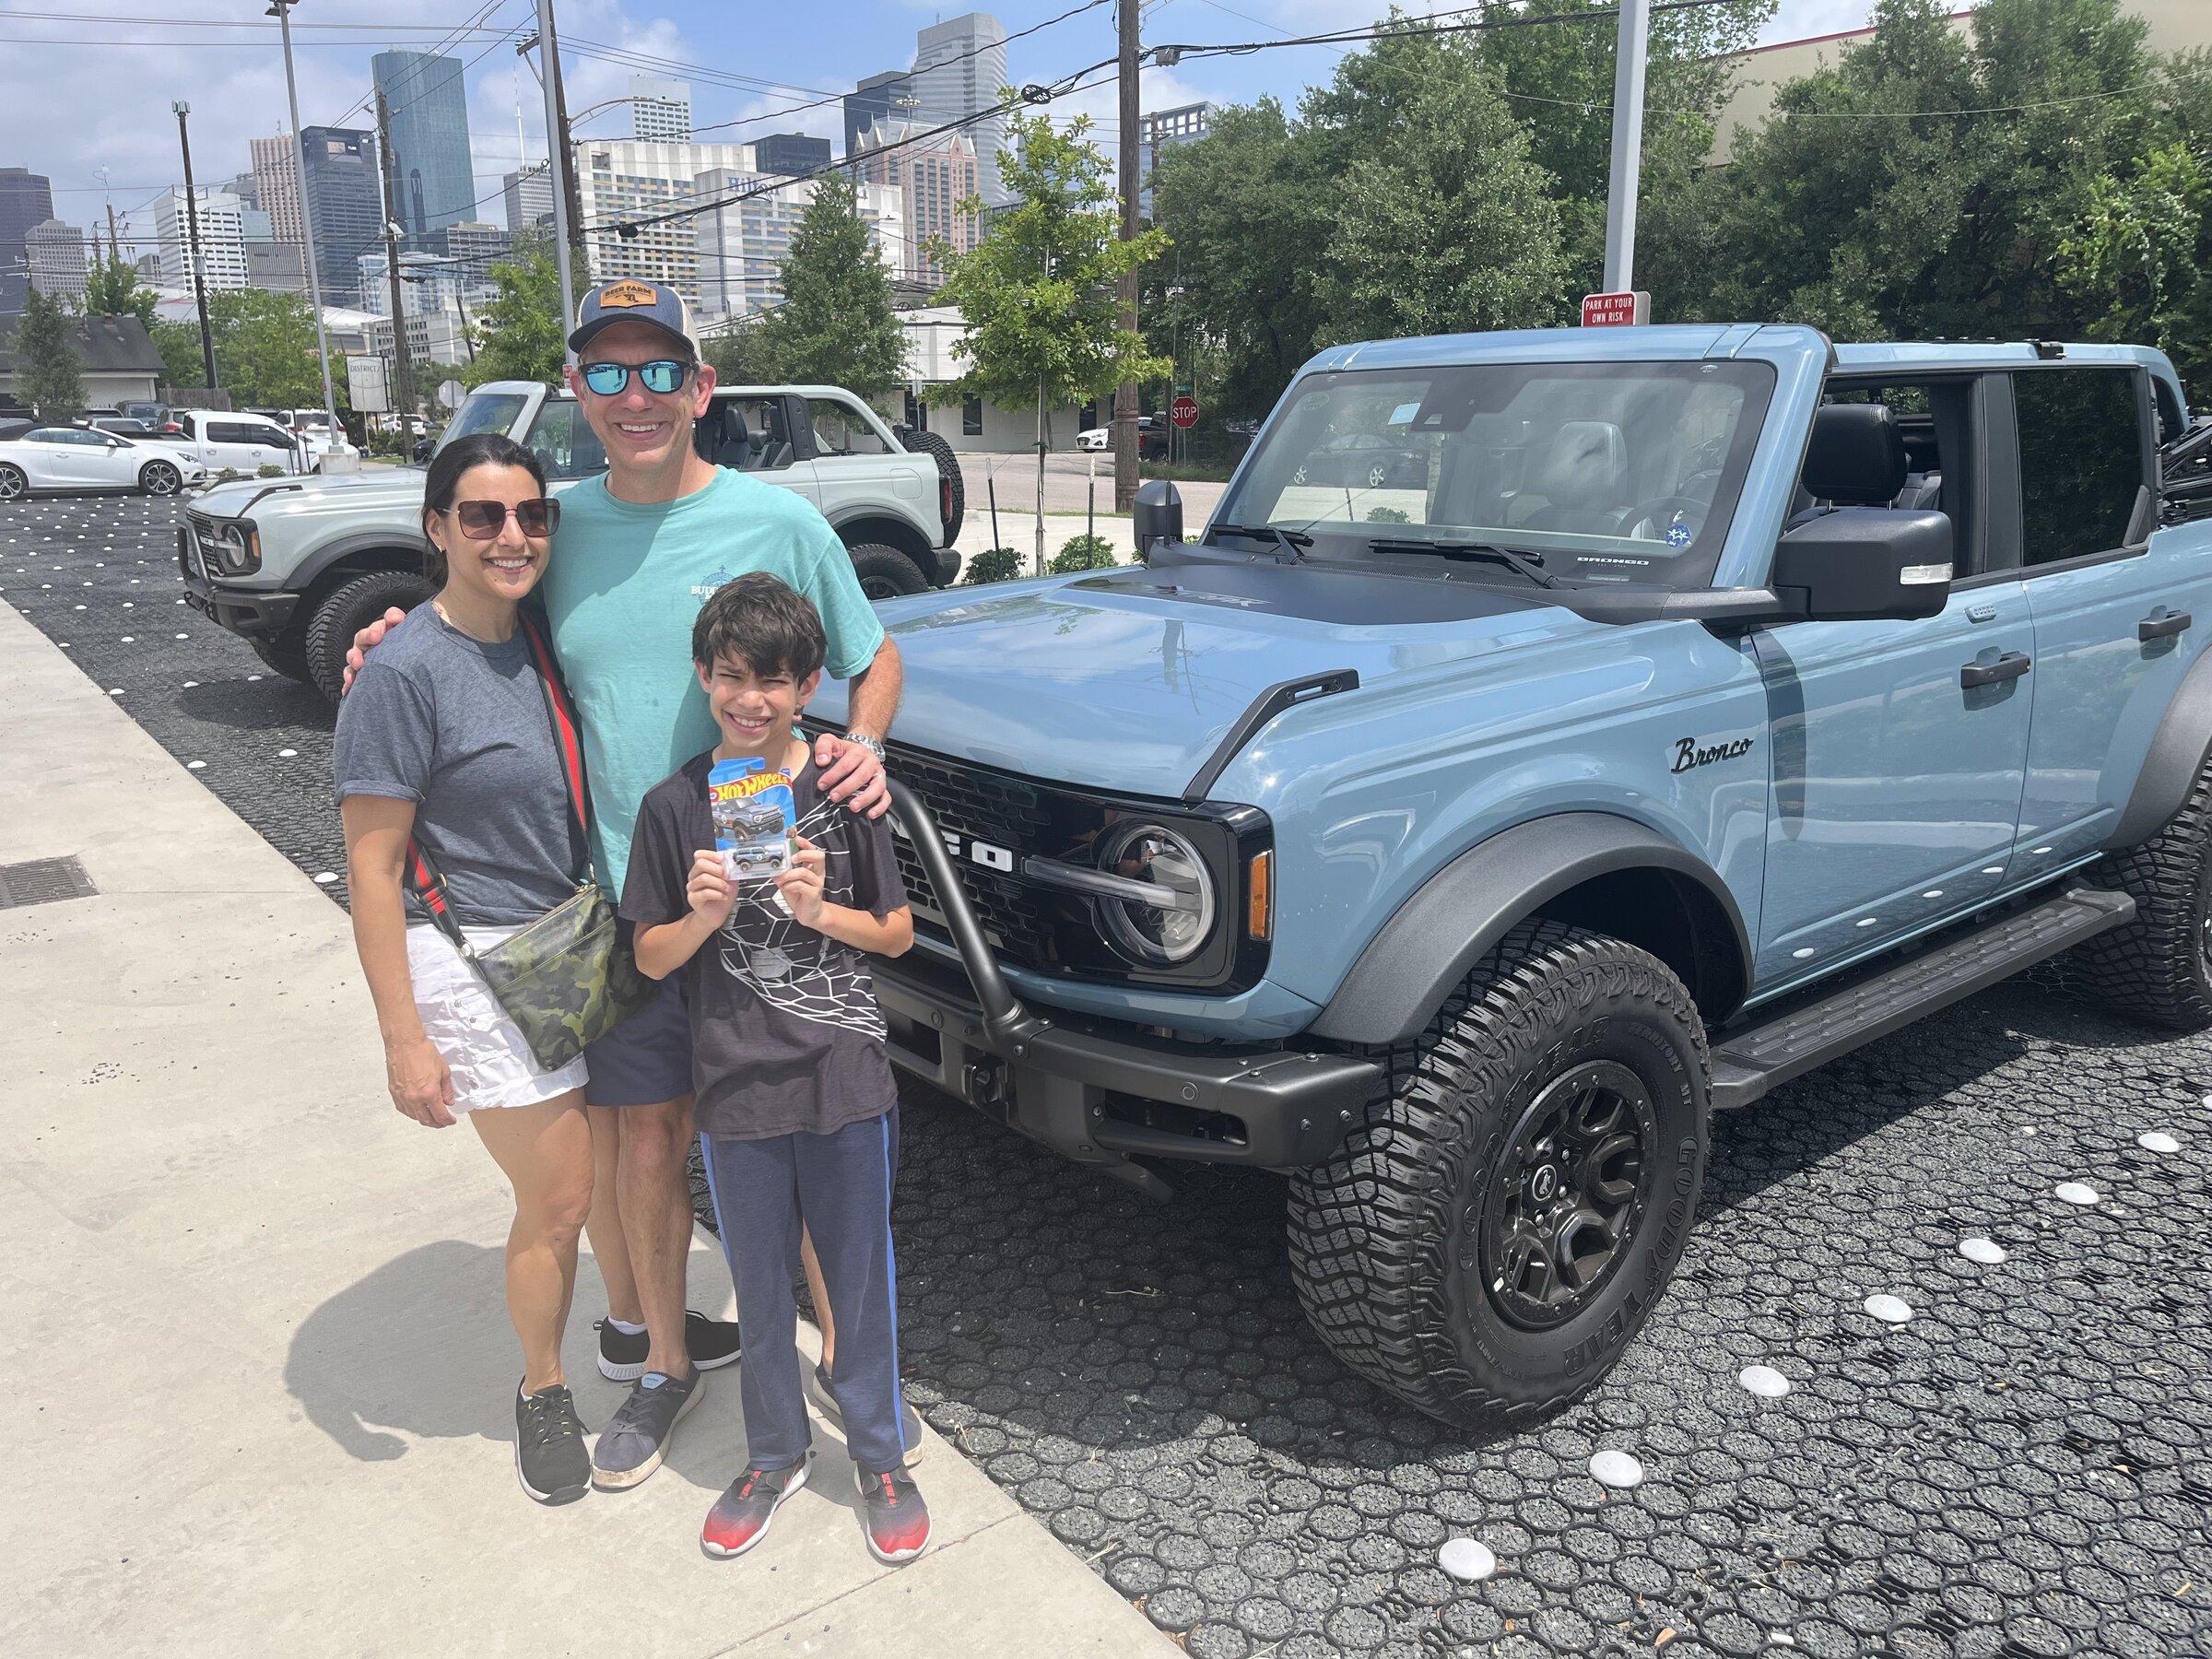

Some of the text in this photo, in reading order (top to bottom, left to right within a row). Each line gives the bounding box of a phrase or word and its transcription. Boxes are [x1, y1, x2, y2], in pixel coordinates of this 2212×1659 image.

[1585, 297, 1632, 312] PARK AT YOUR
[1592, 312, 1624, 324] OWN RISK
[1172, 406, 1197, 419] STOP
[1576, 557, 1650, 566] BRONCO
[1670, 736, 1755, 774] Bronco
[714, 782, 746, 801] HOT
[1654, 1135, 1699, 1259] GOOD
